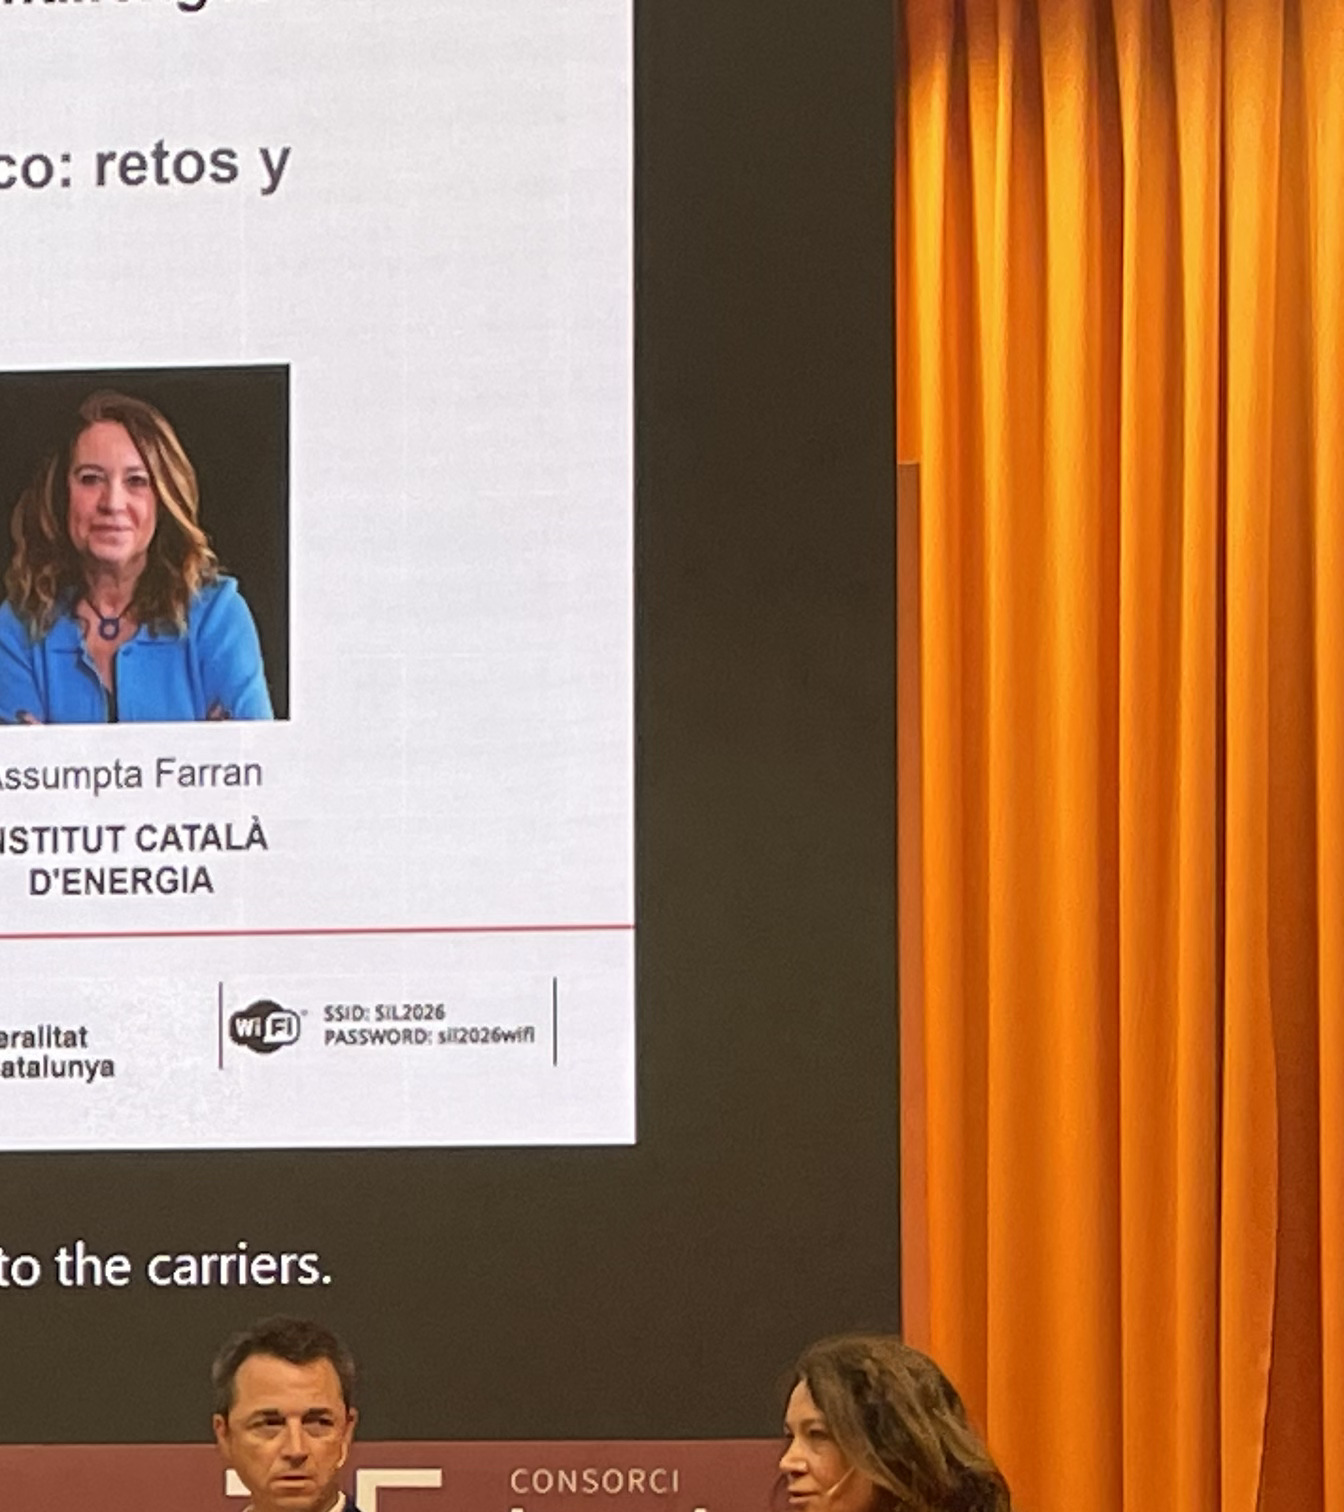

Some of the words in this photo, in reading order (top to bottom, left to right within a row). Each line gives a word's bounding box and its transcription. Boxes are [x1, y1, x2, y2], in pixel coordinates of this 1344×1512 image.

[97, 140, 238, 186] retos
[260, 148, 290, 195] y
[156, 758, 261, 787] Farran
[136, 816, 268, 852] CATALÀ
[30, 866, 213, 895] D'ENERGIA
[325, 1028, 433, 1045] PASSWORD:
[55, 1243, 131, 1286] the
[149, 1242, 331, 1285] carriers.
[511, 1469, 678, 1493] CONSORCI
